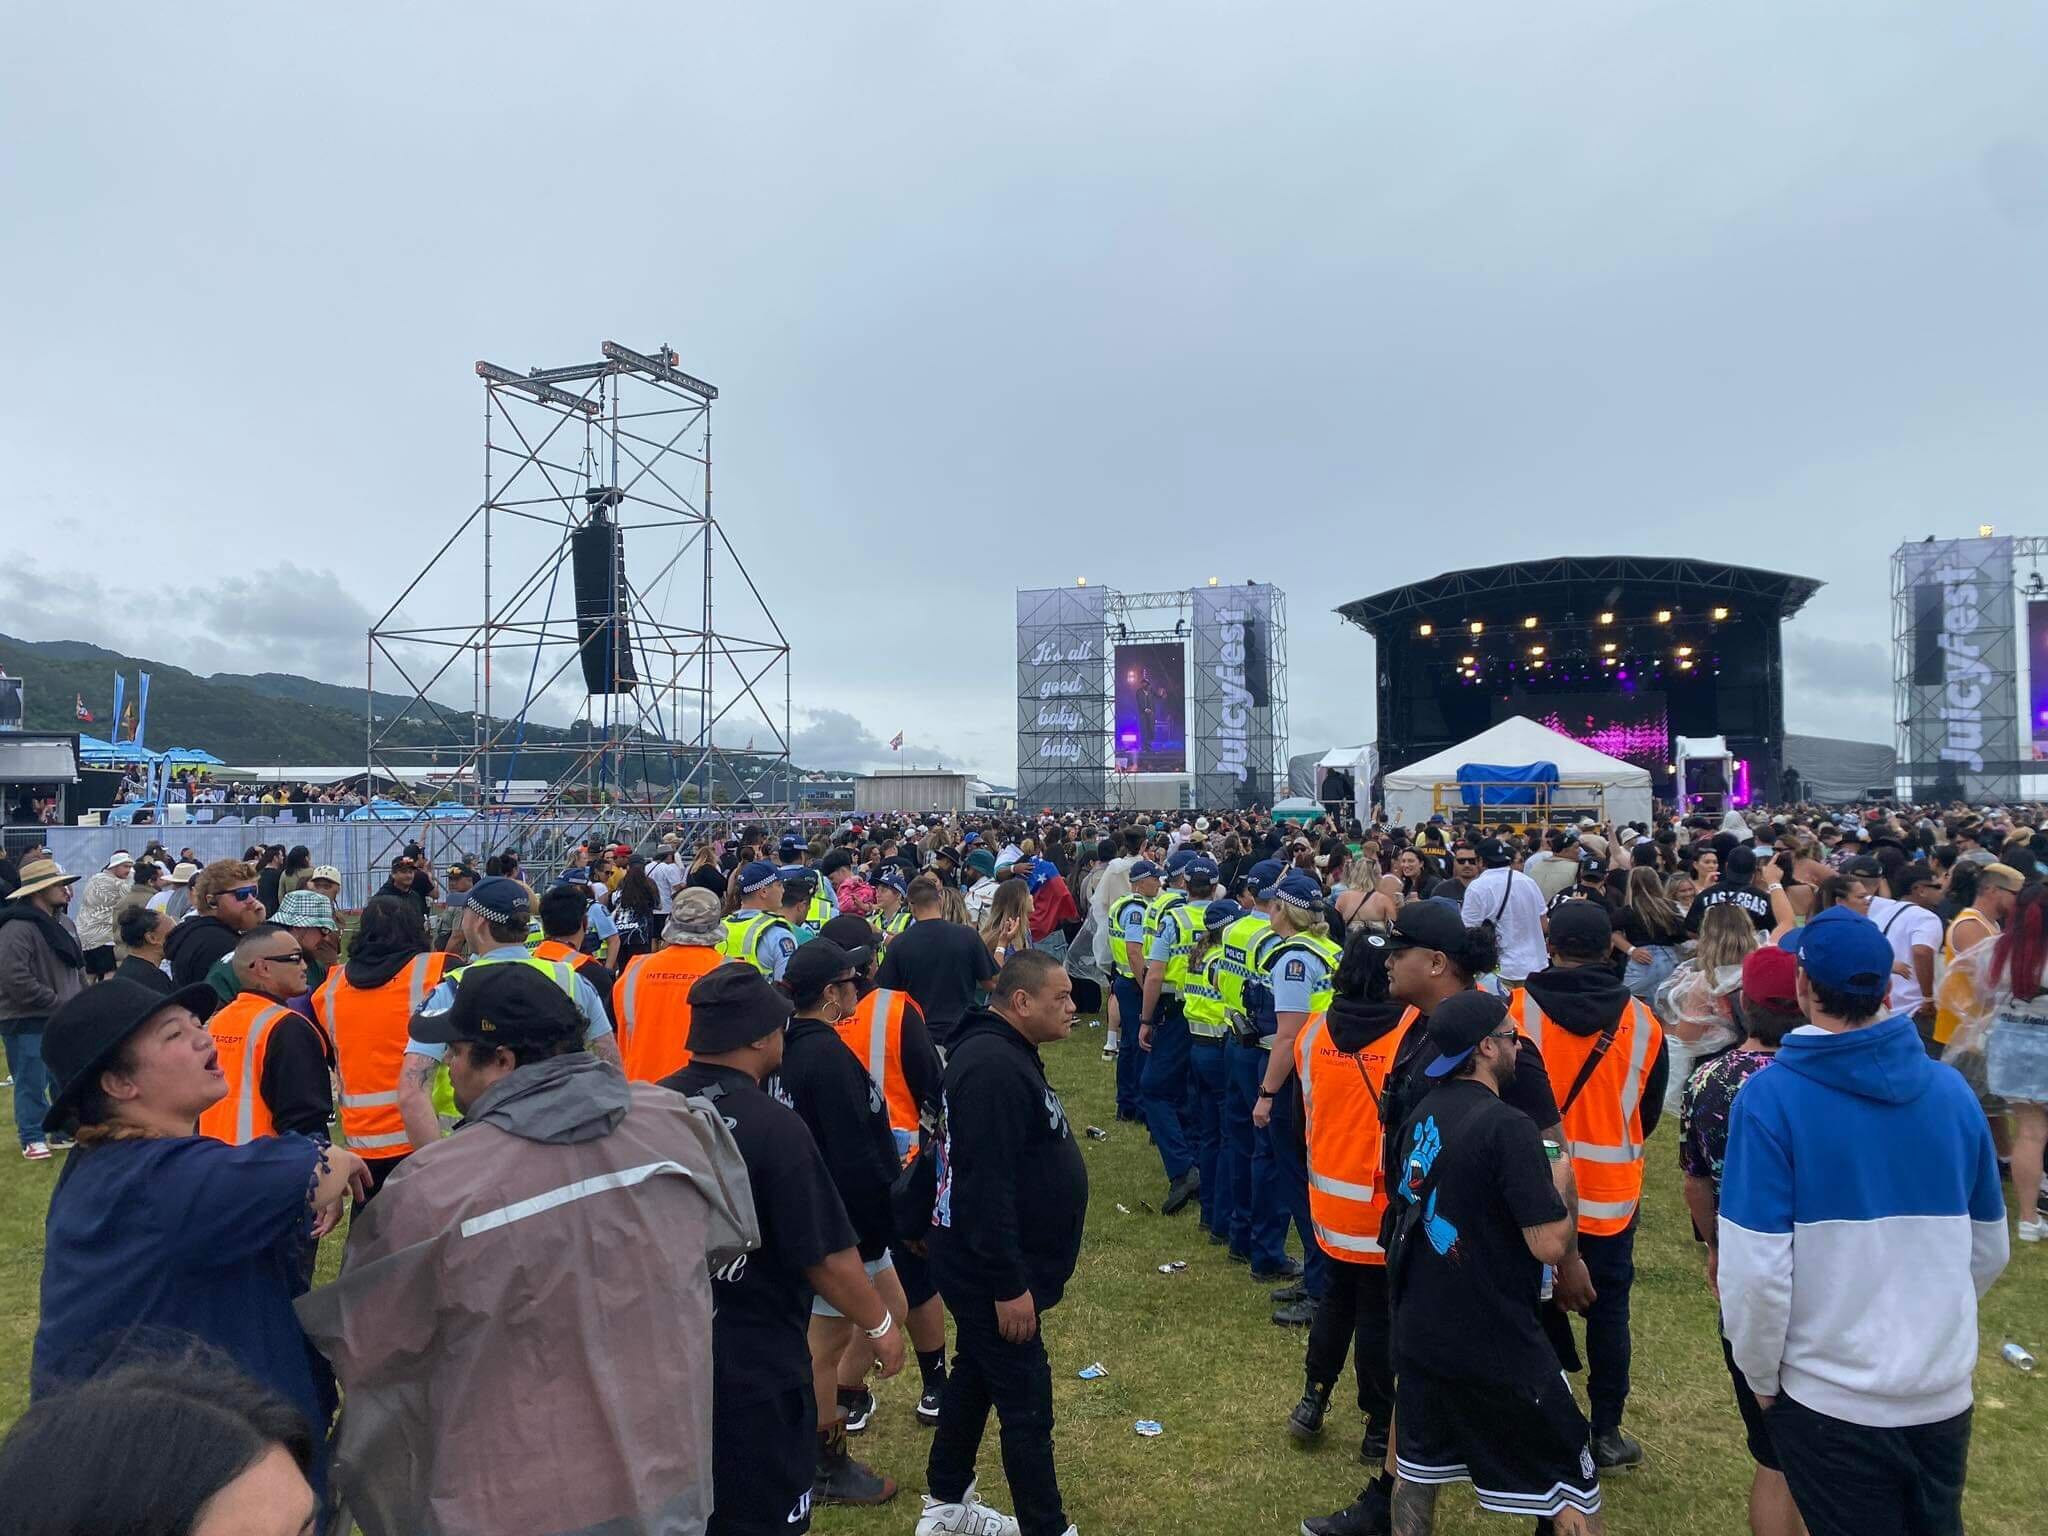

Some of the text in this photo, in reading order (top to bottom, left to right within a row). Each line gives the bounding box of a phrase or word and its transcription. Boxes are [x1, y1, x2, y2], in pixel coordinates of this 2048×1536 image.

[1031, 640, 1093, 666] It's all
[1040, 672, 1083, 699] good
[1040, 736, 1082, 762] baby
[1225, 947, 1245, 961] POLICE
